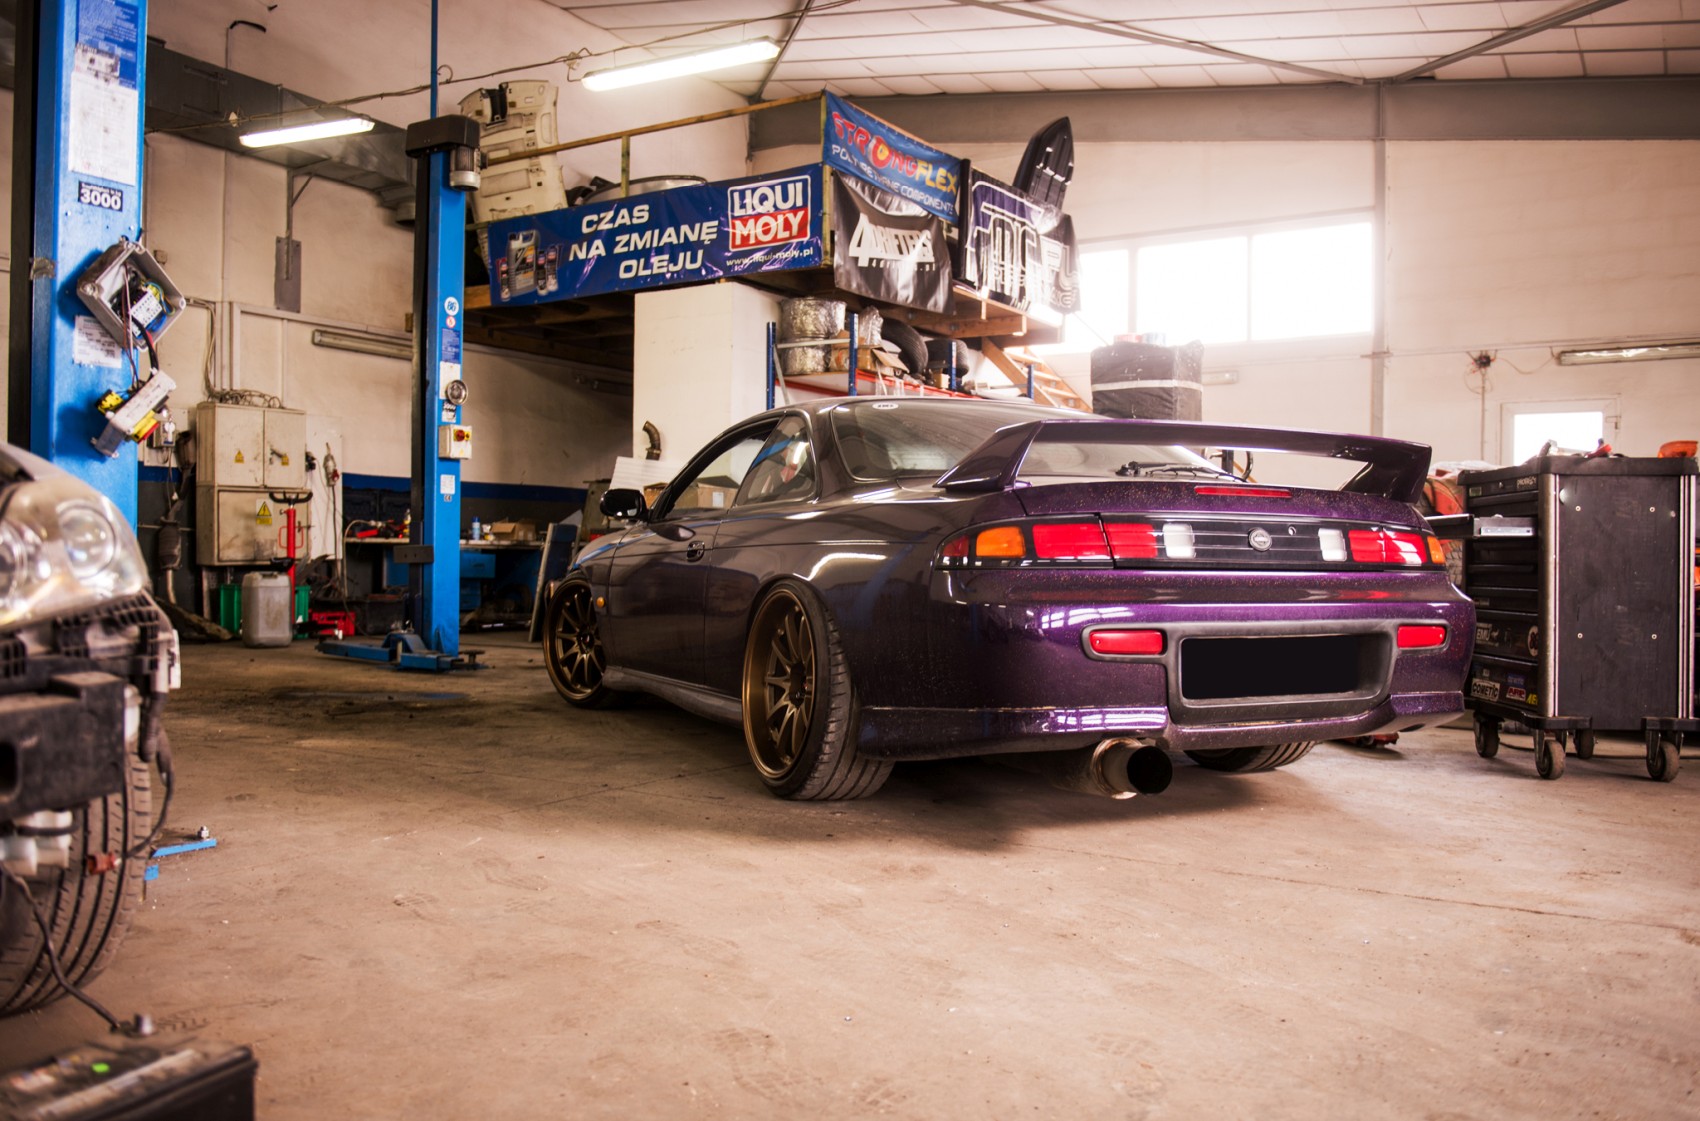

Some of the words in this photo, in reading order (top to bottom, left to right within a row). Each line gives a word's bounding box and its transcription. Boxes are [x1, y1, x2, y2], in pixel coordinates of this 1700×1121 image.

[832, 111, 957, 195] STRONGFLEX
[80, 188, 122, 210] 3000
[732, 181, 804, 217] LIQUI
[581, 204, 650, 234] CZAS
[731, 211, 804, 247] MOLY
[569, 239, 606, 262] NA
[613, 220, 719, 252] ZMIANĘ
[619, 249, 704, 279] OLEJU
[726, 246, 814, 267] www.liqui-moly.pl
[1472, 682, 1499, 698] COMETIC
